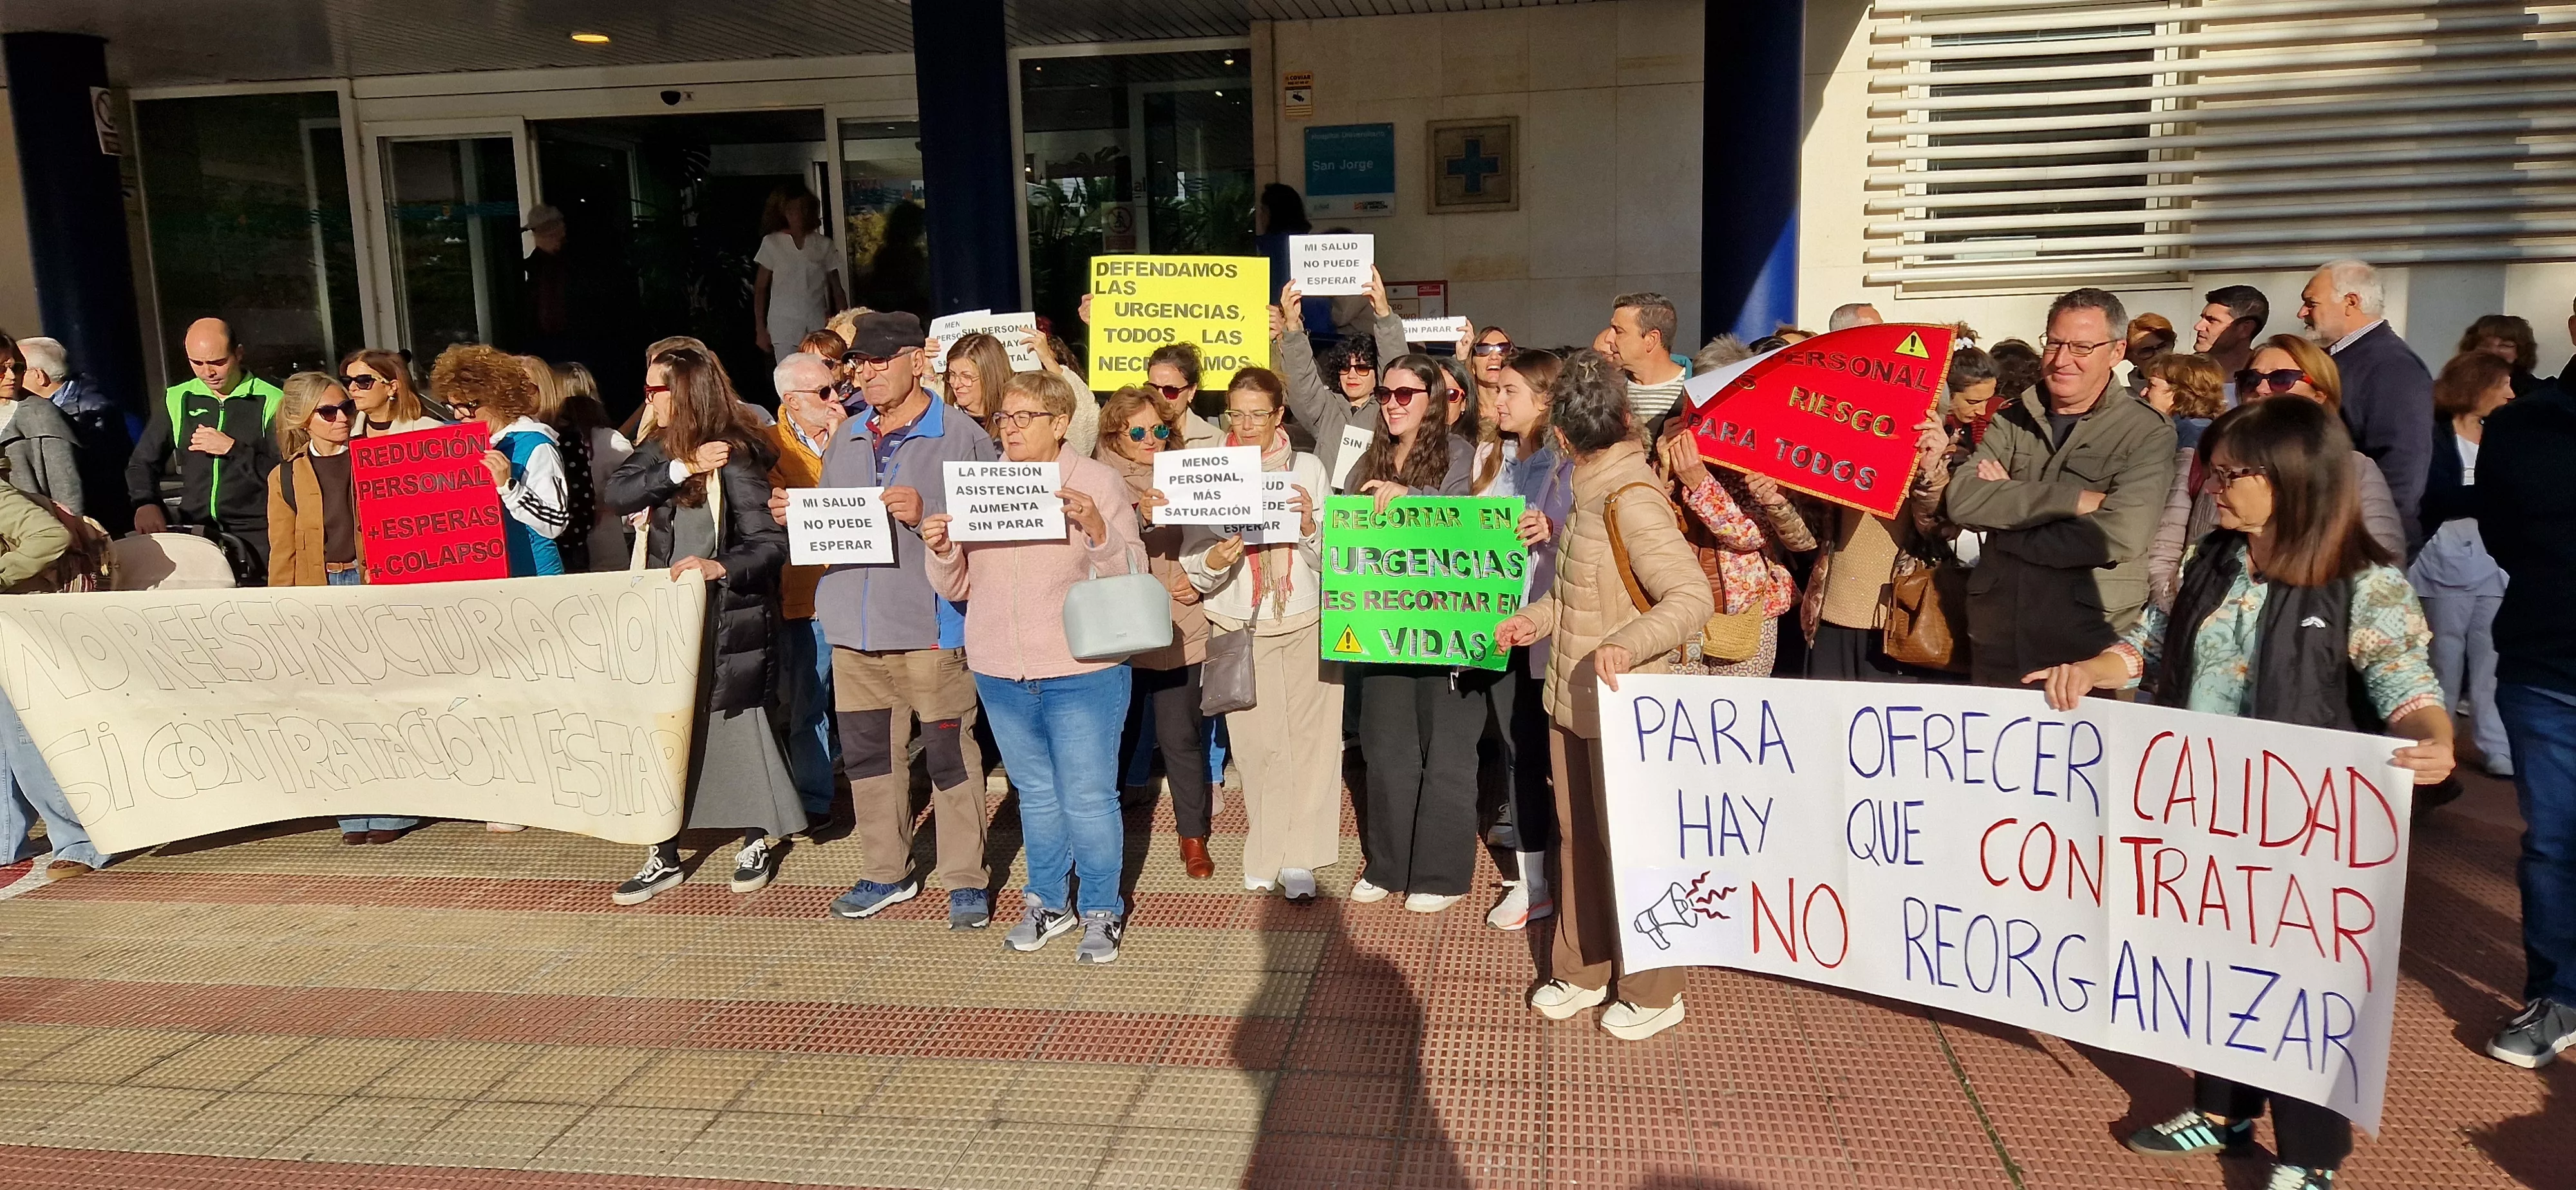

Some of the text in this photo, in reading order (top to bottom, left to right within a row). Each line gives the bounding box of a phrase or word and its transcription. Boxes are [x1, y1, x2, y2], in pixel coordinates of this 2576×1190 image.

[1312, 160, 1374, 171] San Jorge
[1321, 242, 1358, 250] SALUD
[1097, 261, 1238, 278] DEFENDAMOS
[1323, 259, 1360, 268] PUEDE
[1307, 276, 1356, 285] ESPERAR
[1095, 280, 1137, 296] LAS
[1115, 302, 1245, 322] URGENCIAS,
[962, 328, 978, 336] SIN
[1104, 328, 1242, 345] TODOS LAS
[1788, 385, 1896, 437] RIESGO
[357, 429, 486, 469] REDUCIÓN
[1343, 437, 1362, 449] SIN
[1687, 411, 1877, 491] PARA TODOS
[1182, 456, 1229, 468] MENOS
[959, 464, 1043, 477] LA PRESIÓN
[358, 466, 491, 500] PERSONAL
[1169, 473, 1244, 485] PERSONAL,
[956, 485, 1049, 495] ASISTENCIAL
[1193, 488, 1222, 500] MÁS
[802, 497, 866, 508] MI SALUD
[970, 502, 1039, 513] AUMENTA
[1164, 505, 1251, 516] SATURACIÓN
[381, 505, 500, 540] ESPERAS
[804, 518, 873, 530] NO PUEDE
[969, 518, 1044, 531] SIN PARAR
[1332, 507, 1512, 530] RECORTAR EN
[1224, 521, 1280, 533] ESPERAR
[810, 540, 873, 551] ESPERAR
[385, 538, 504, 576] COLAPSO
[1329, 546, 1525, 581] URGENCIAS
[1323, 589, 1522, 616] ES RECORTAR EN
[1379, 627, 1488, 663] VIDAS
[1633, 695, 2400, 869] PARA OFRECER CALIDAD
[1678, 788, 2376, 993] HAY QUE CONTRATAR
[1750, 876, 2360, 1105] NO REORGANIZAR
